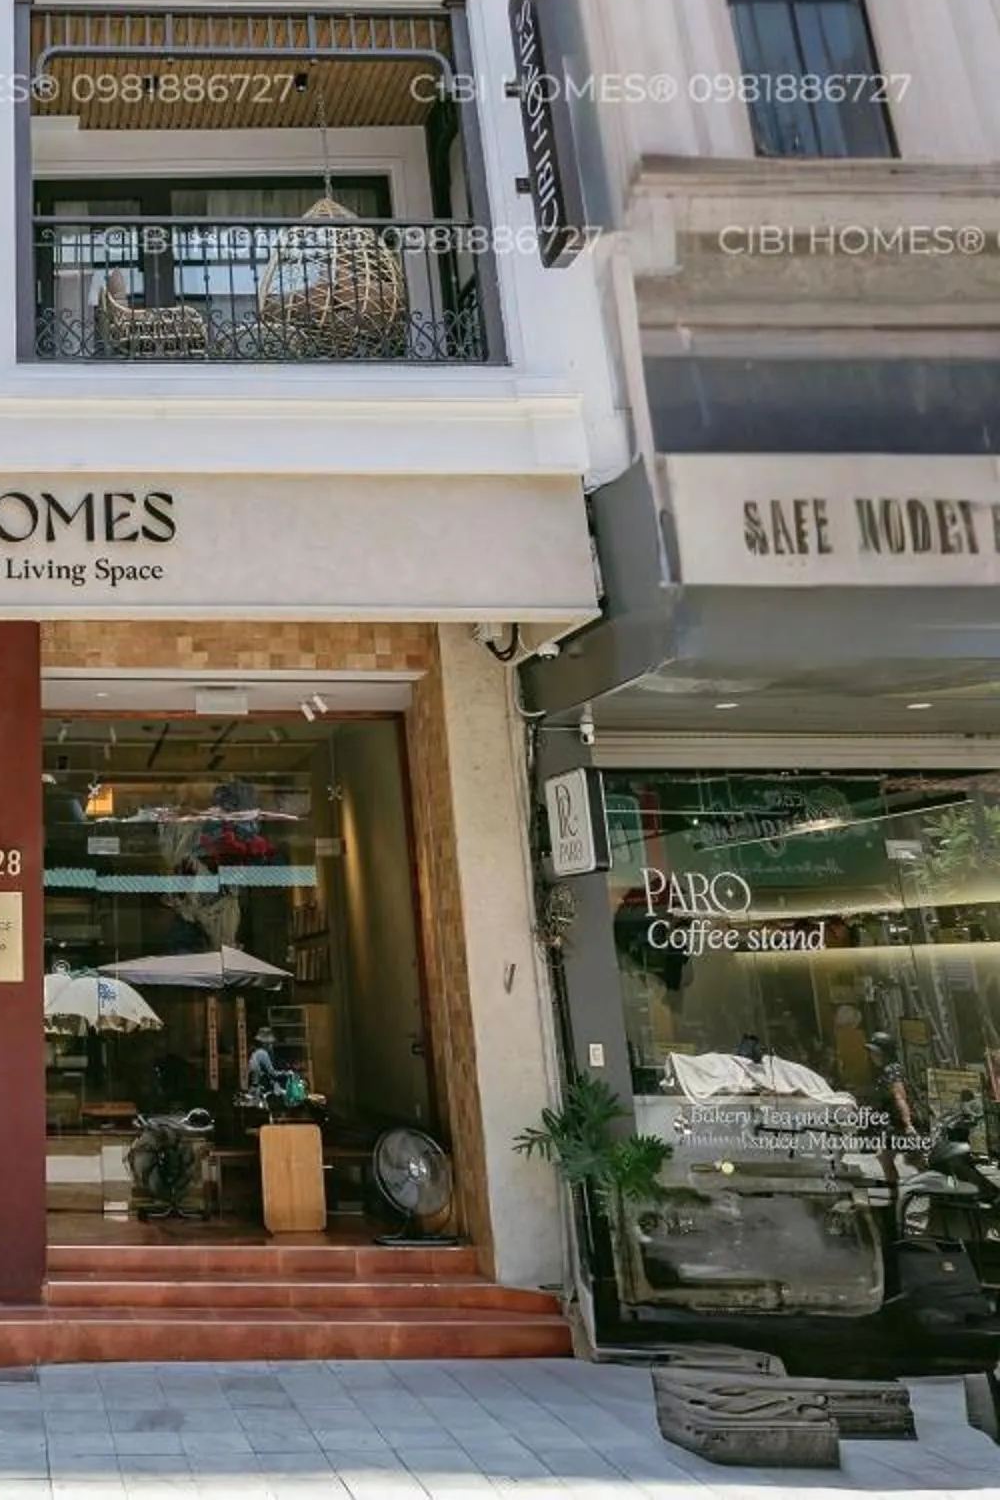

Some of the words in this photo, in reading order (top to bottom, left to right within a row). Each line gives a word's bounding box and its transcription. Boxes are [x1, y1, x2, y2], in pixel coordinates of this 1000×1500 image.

[4, 557, 87, 586] Living
[95, 558, 164, 587] Space
[640, 867, 751, 917] PARO
[647, 919, 740, 956] Coffee
[747, 921, 827, 951] stand
[833, 1107, 890, 1128] Coffee
[808, 1131, 887, 1151] Maximal
